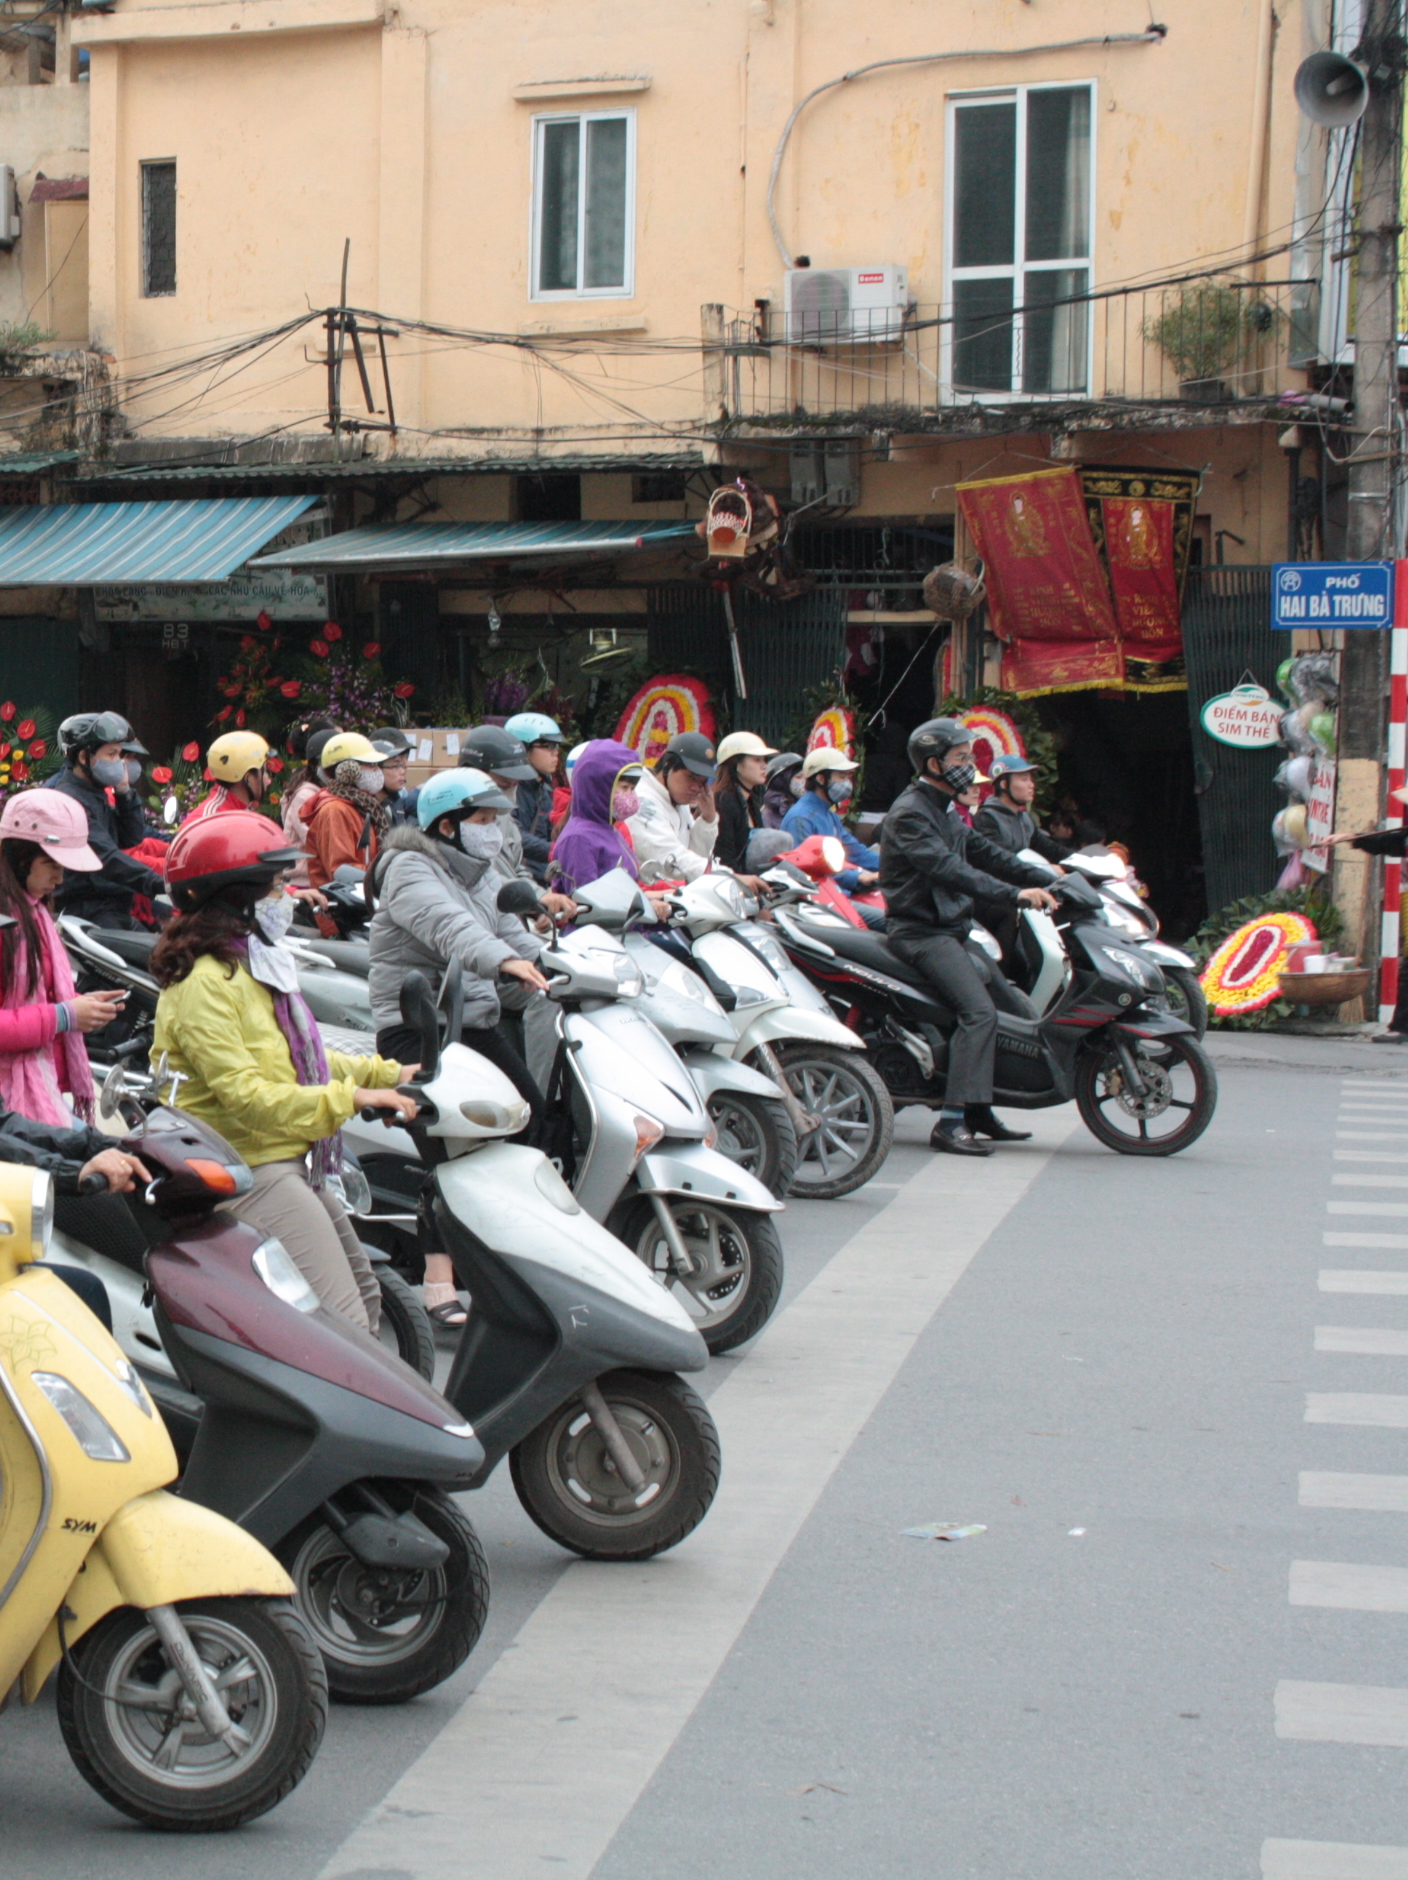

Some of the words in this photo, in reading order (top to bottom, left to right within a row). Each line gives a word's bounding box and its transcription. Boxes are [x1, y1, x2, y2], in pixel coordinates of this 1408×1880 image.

[1325, 572, 1362, 589] PHỐ
[1280, 595, 1306, 618] HAI
[1309, 590, 1330, 617] BÀ
[1333, 592, 1385, 617] TRƯNG
[163, 623, 189, 639] 83
[162, 639, 190, 649] HBT
[1213, 705, 1248, 722] ĐIỂM
[1250, 712, 1281, 724] BÁN
[1217, 722, 1242, 736] SIM
[1244, 724, 1271, 739] THẺ
[843, 964, 902, 992] NOUVO
[996, 1033, 1039, 1059] YAMAHA
[60, 1518, 98, 1534] SYM
